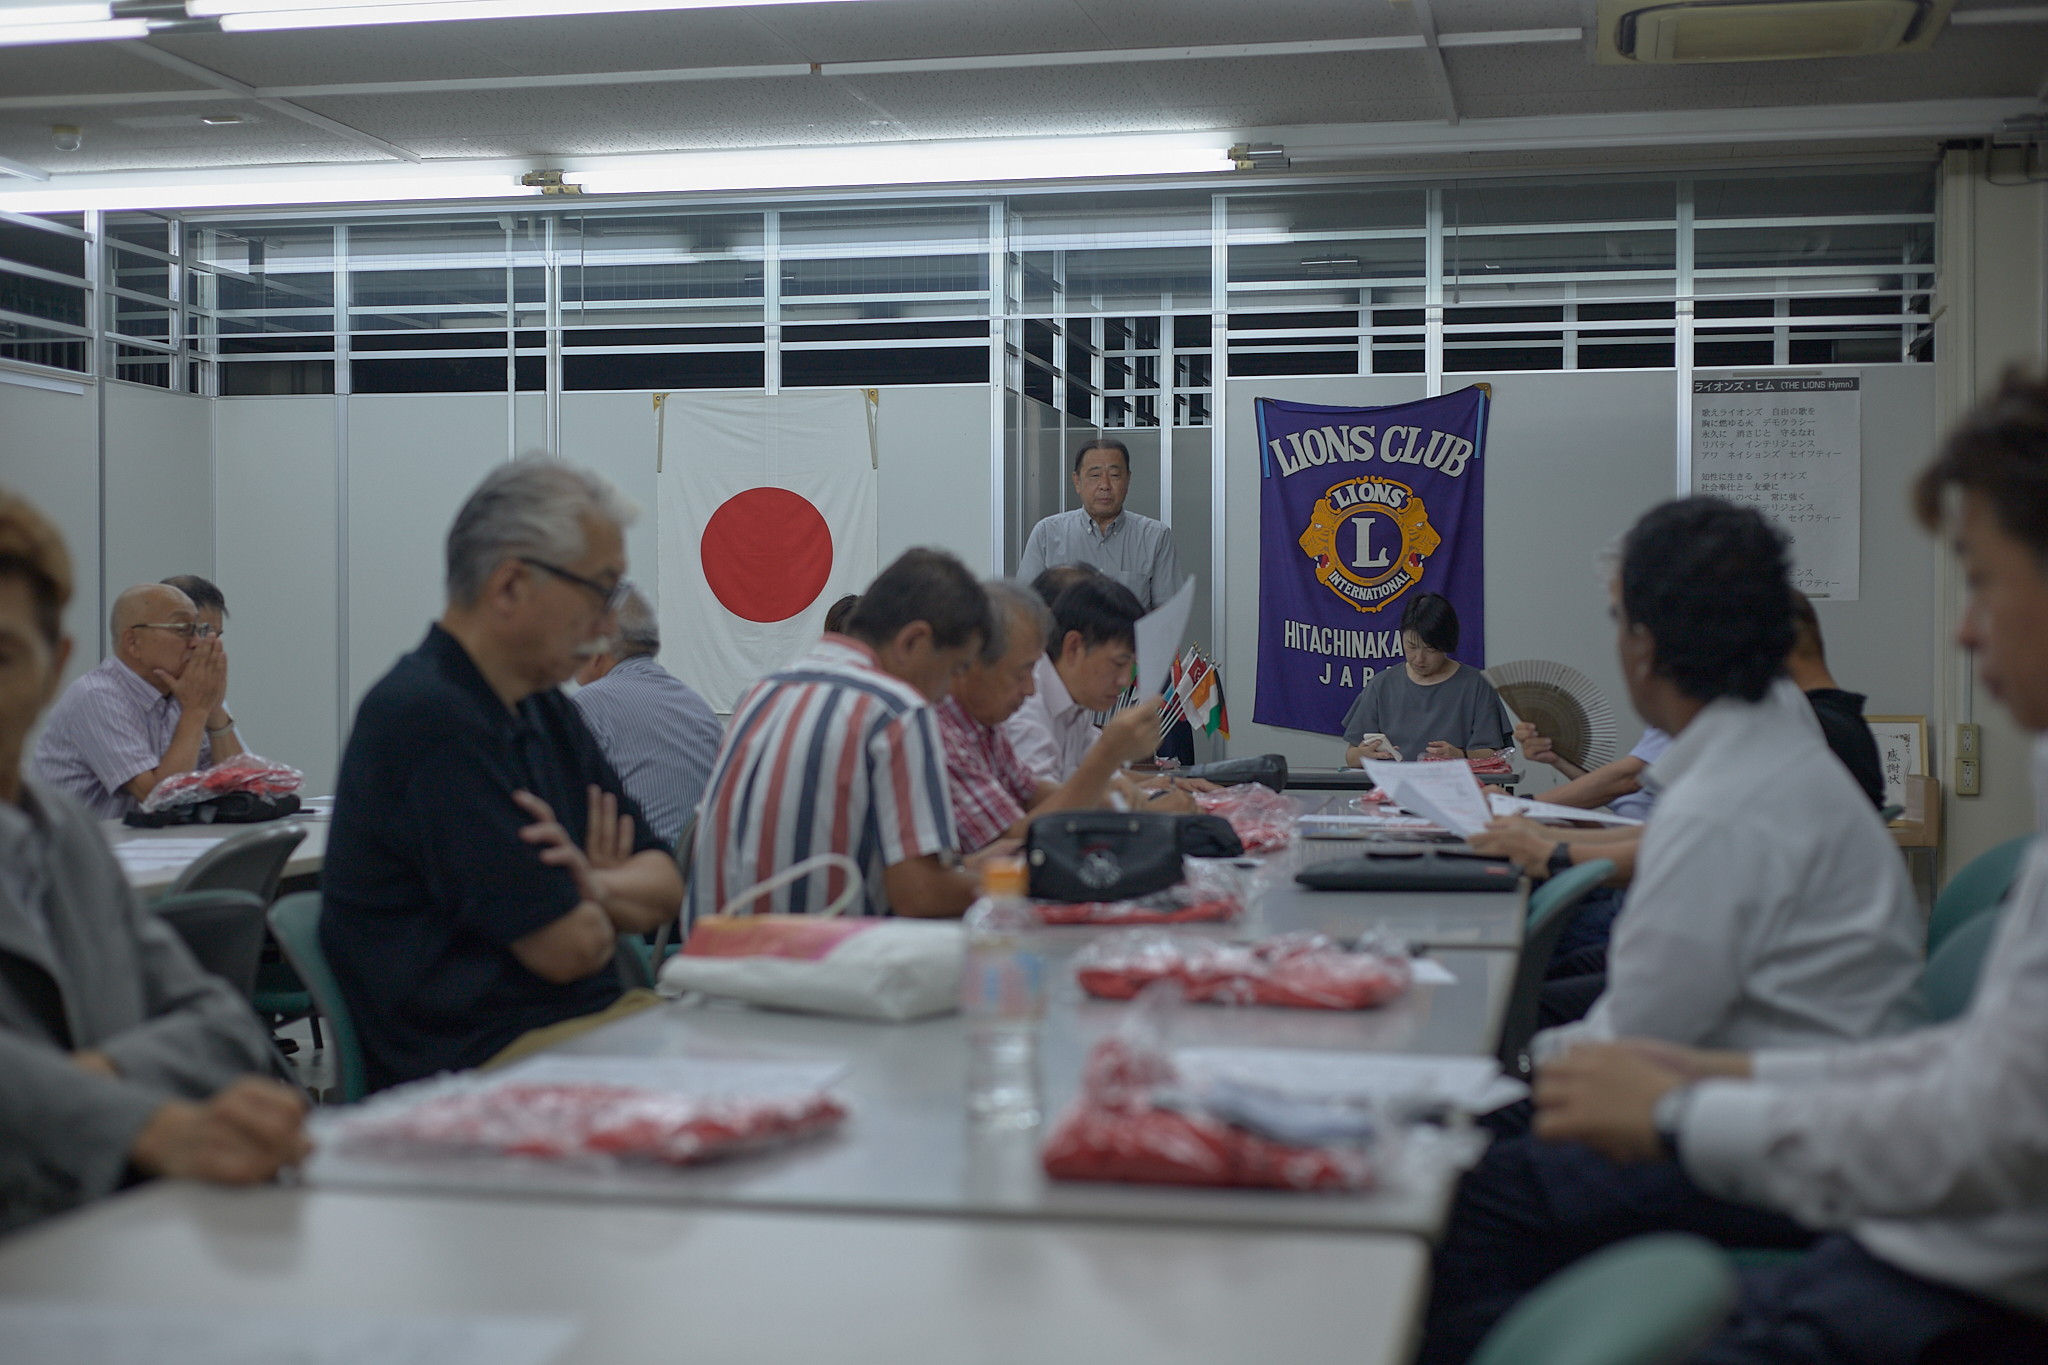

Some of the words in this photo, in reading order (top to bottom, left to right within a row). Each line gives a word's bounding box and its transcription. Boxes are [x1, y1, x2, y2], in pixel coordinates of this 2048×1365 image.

[1694, 380, 1775, 392] ライオンズ・ヒム
[1803, 380, 1826, 389] LIONS
[1701, 407, 1763, 417] 歌えライオンズ
[1772, 406, 1816, 416] 自由の歌を
[1762, 418, 1816, 427] デモクラシー
[1701, 430, 1728, 439] 永久に
[1736, 430, 1771, 438] 消さじと
[1780, 429, 1816, 437] 守るなれ
[1745, 439, 1815, 448] インテリジェンス
[1269, 425, 1375, 477] LIONS
[1380, 425, 1474, 477] CLUB
[1701, 451, 1718, 460] アワ
[1727, 450, 1780, 459] ネイションズ
[1789, 449, 1842, 459] セイフティー
[1701, 472, 1753, 481] 知性に生きる
[1762, 471, 1807, 480] ライオンズ
[1701, 483, 1744, 492] 社会奉仕と
[1753, 483, 1779, 491] 友愛に
[1332, 483, 1406, 508] LIONS
[1771, 492, 1805, 501] 常に強く
[1788, 513, 1842, 523] セイフティー
[1351, 517, 1390, 568] L
[1328, 570, 1411, 601] INTERNATIONAL
[1284, 619, 1404, 659] HITACHINAKA
[1319, 662, 1392, 688] JAP
[1886, 748, 1901, 785] 感謝状
